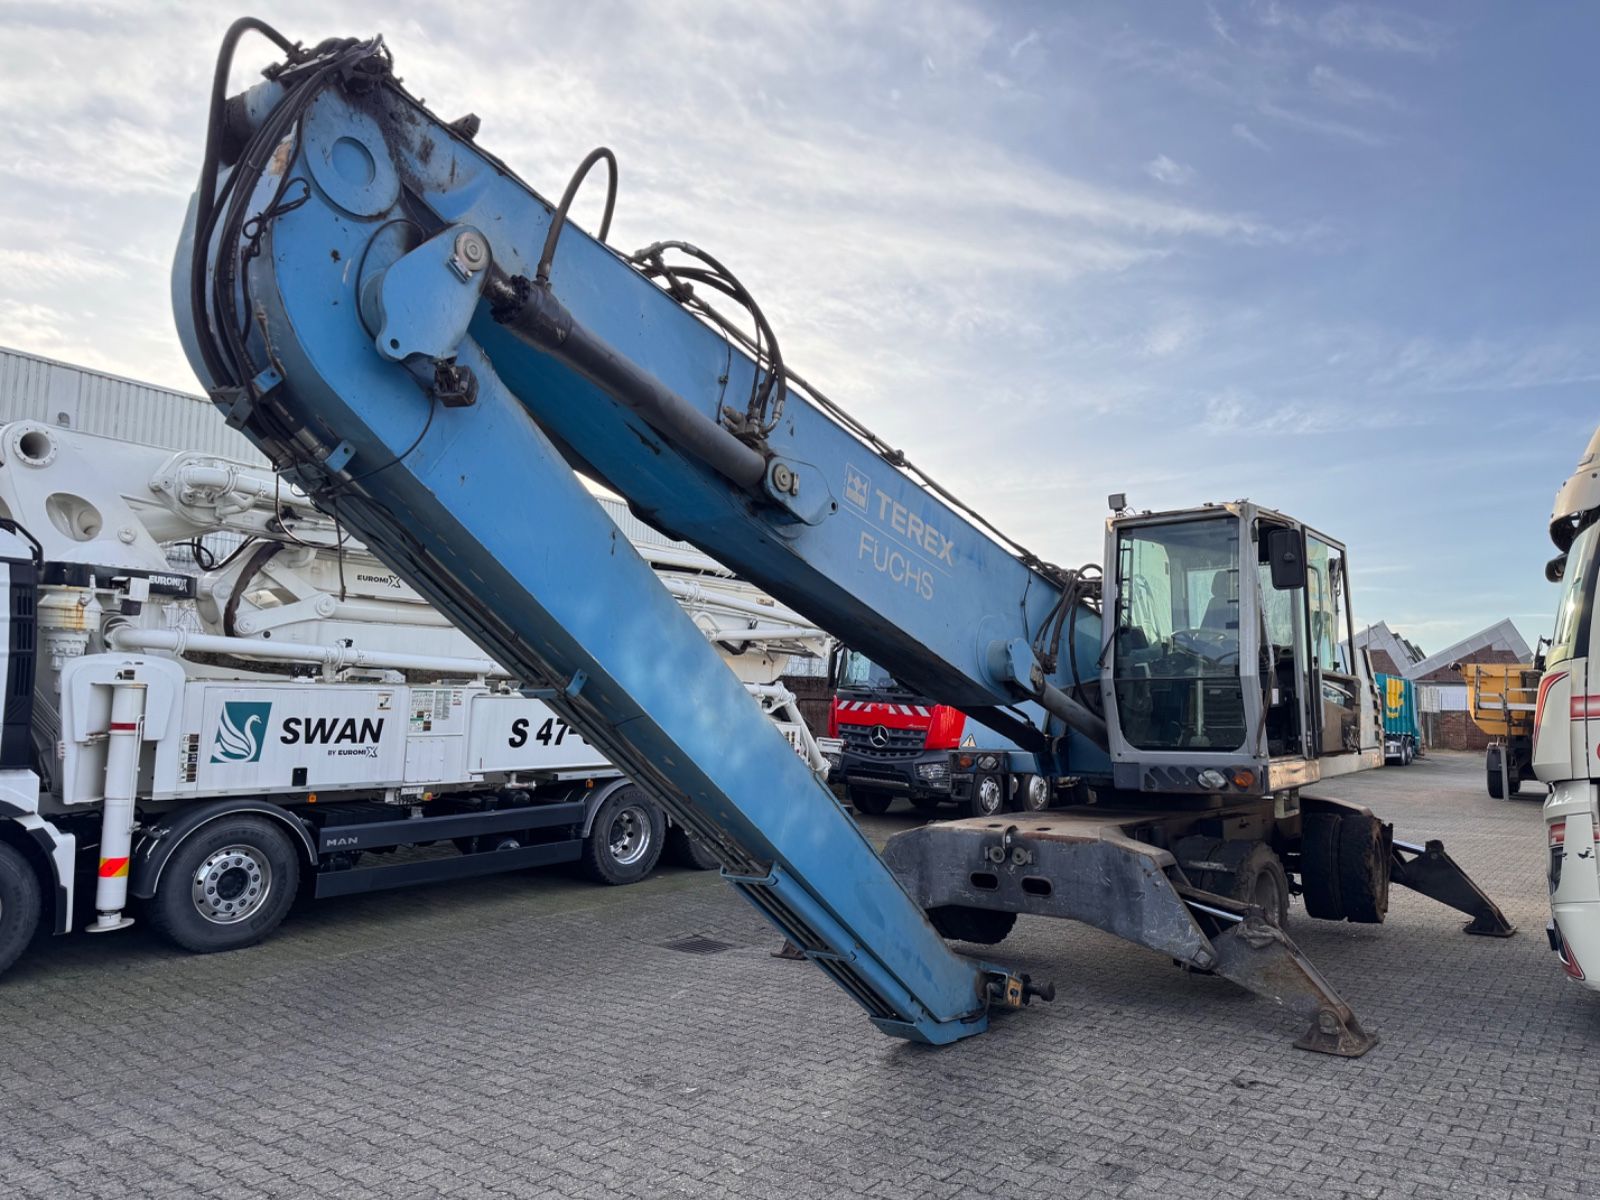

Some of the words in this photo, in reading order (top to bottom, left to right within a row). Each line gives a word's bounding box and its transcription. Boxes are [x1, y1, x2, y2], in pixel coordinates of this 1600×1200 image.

[875, 488, 954, 567] TEREX
[858, 530, 934, 600] FUCHS
[148, 574, 188, 592] EUROMIX
[356, 574, 401, 588] EUROMIX
[280, 717, 385, 745] SWAN
[508, 718, 530, 748] S
[337, 746, 378, 758] EUROMIX
[326, 836, 359, 847] MAN
